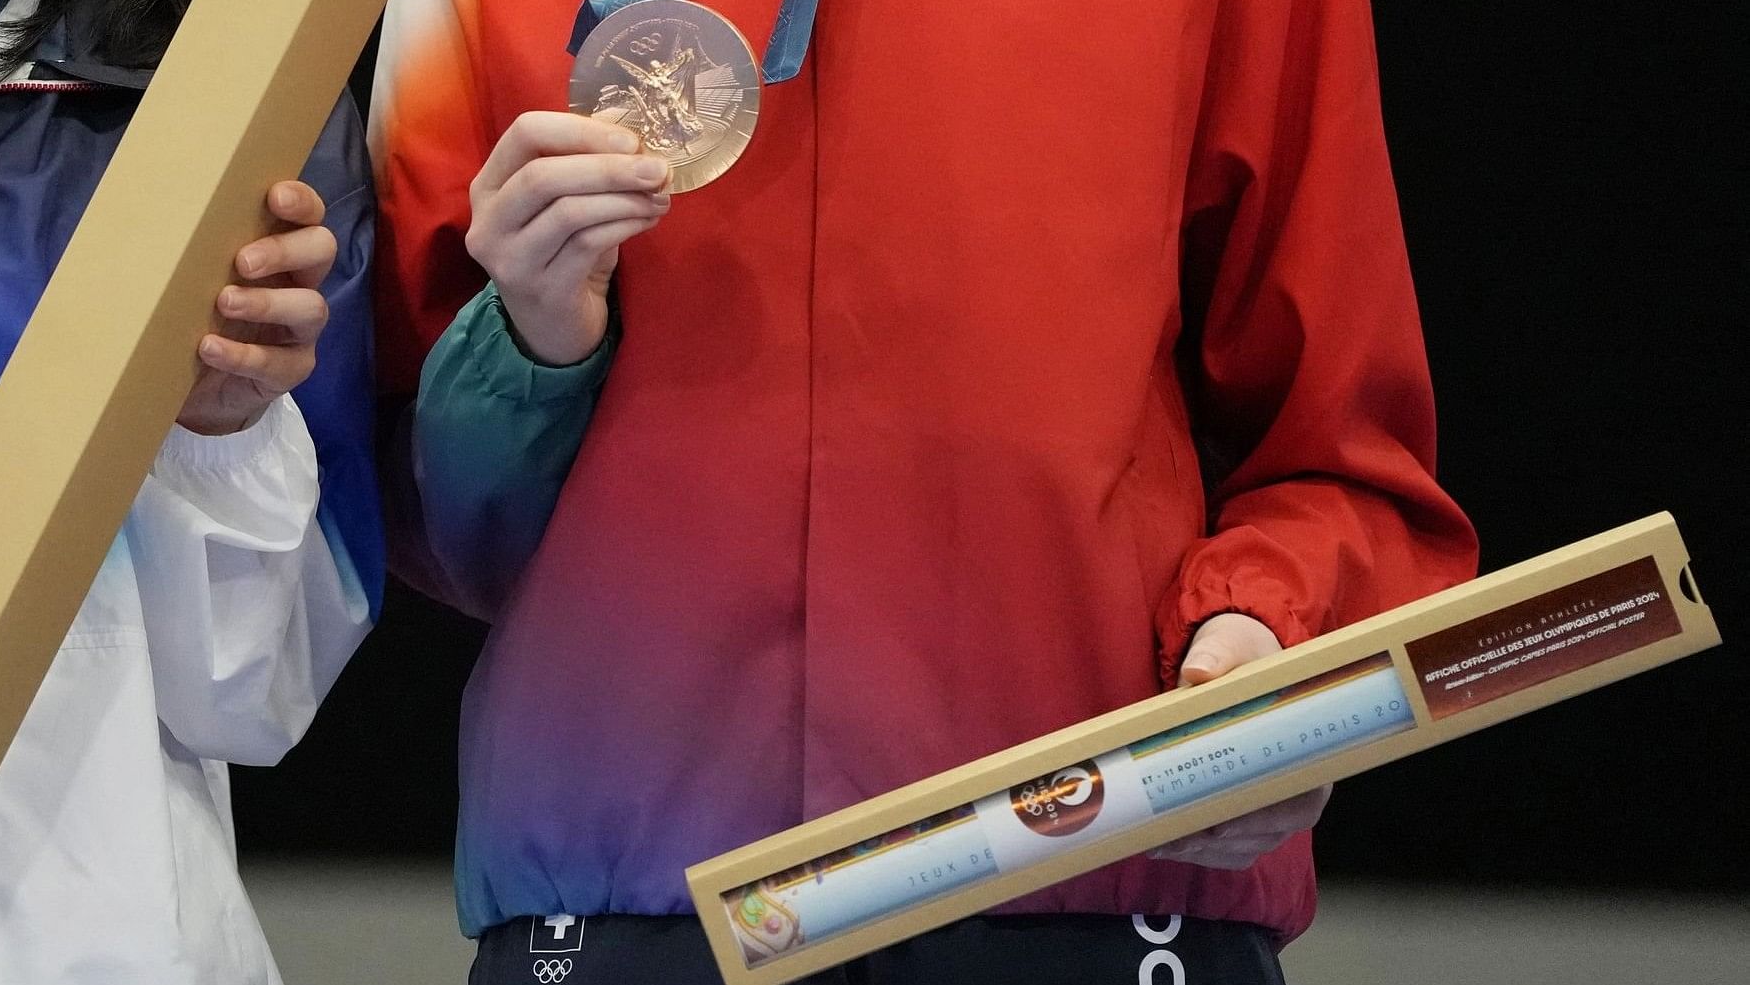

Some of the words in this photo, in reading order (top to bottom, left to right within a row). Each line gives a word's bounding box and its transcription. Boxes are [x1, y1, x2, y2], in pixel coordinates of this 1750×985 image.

[1425, 663, 1460, 681] AFFICHE
[1460, 646, 1507, 669] OFFICIELLE
[1507, 641, 1523, 652] DES
[1524, 633, 1543, 646] JEUX
[1544, 613, 1598, 639] OLYMPIQUES
[1599, 609, 1610, 618] DE
[1610, 600, 1635, 614] PARIS
[1636, 591, 1659, 604] 2024
[1299, 714, 1360, 742] PARIS
